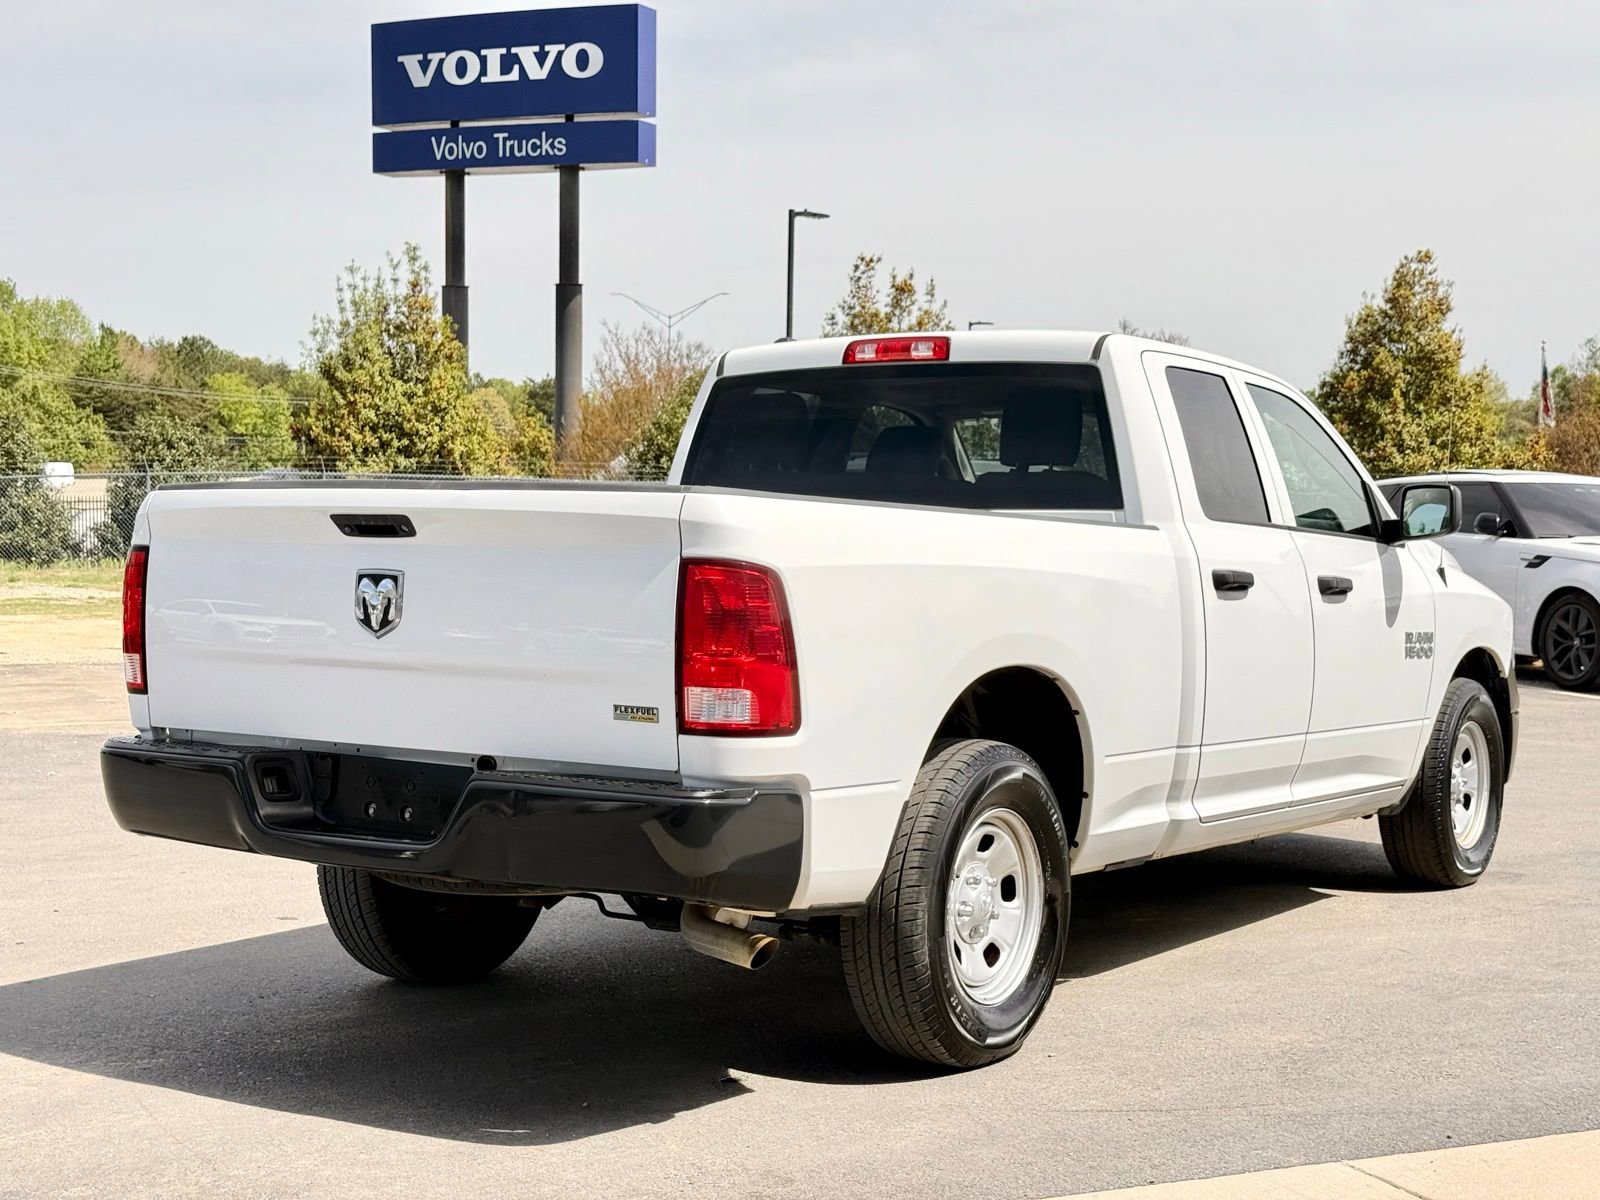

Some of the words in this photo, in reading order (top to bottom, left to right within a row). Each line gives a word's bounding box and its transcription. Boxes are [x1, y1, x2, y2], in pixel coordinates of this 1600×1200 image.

[397, 42, 604, 88] VOLVO
[431, 135, 487, 161] Volvo
[493, 131, 567, 158] Trucks
[1405, 631, 1434, 645] RAM
[1405, 645, 1433, 660] 1500
[614, 706, 657, 716] FLEXFUEL
